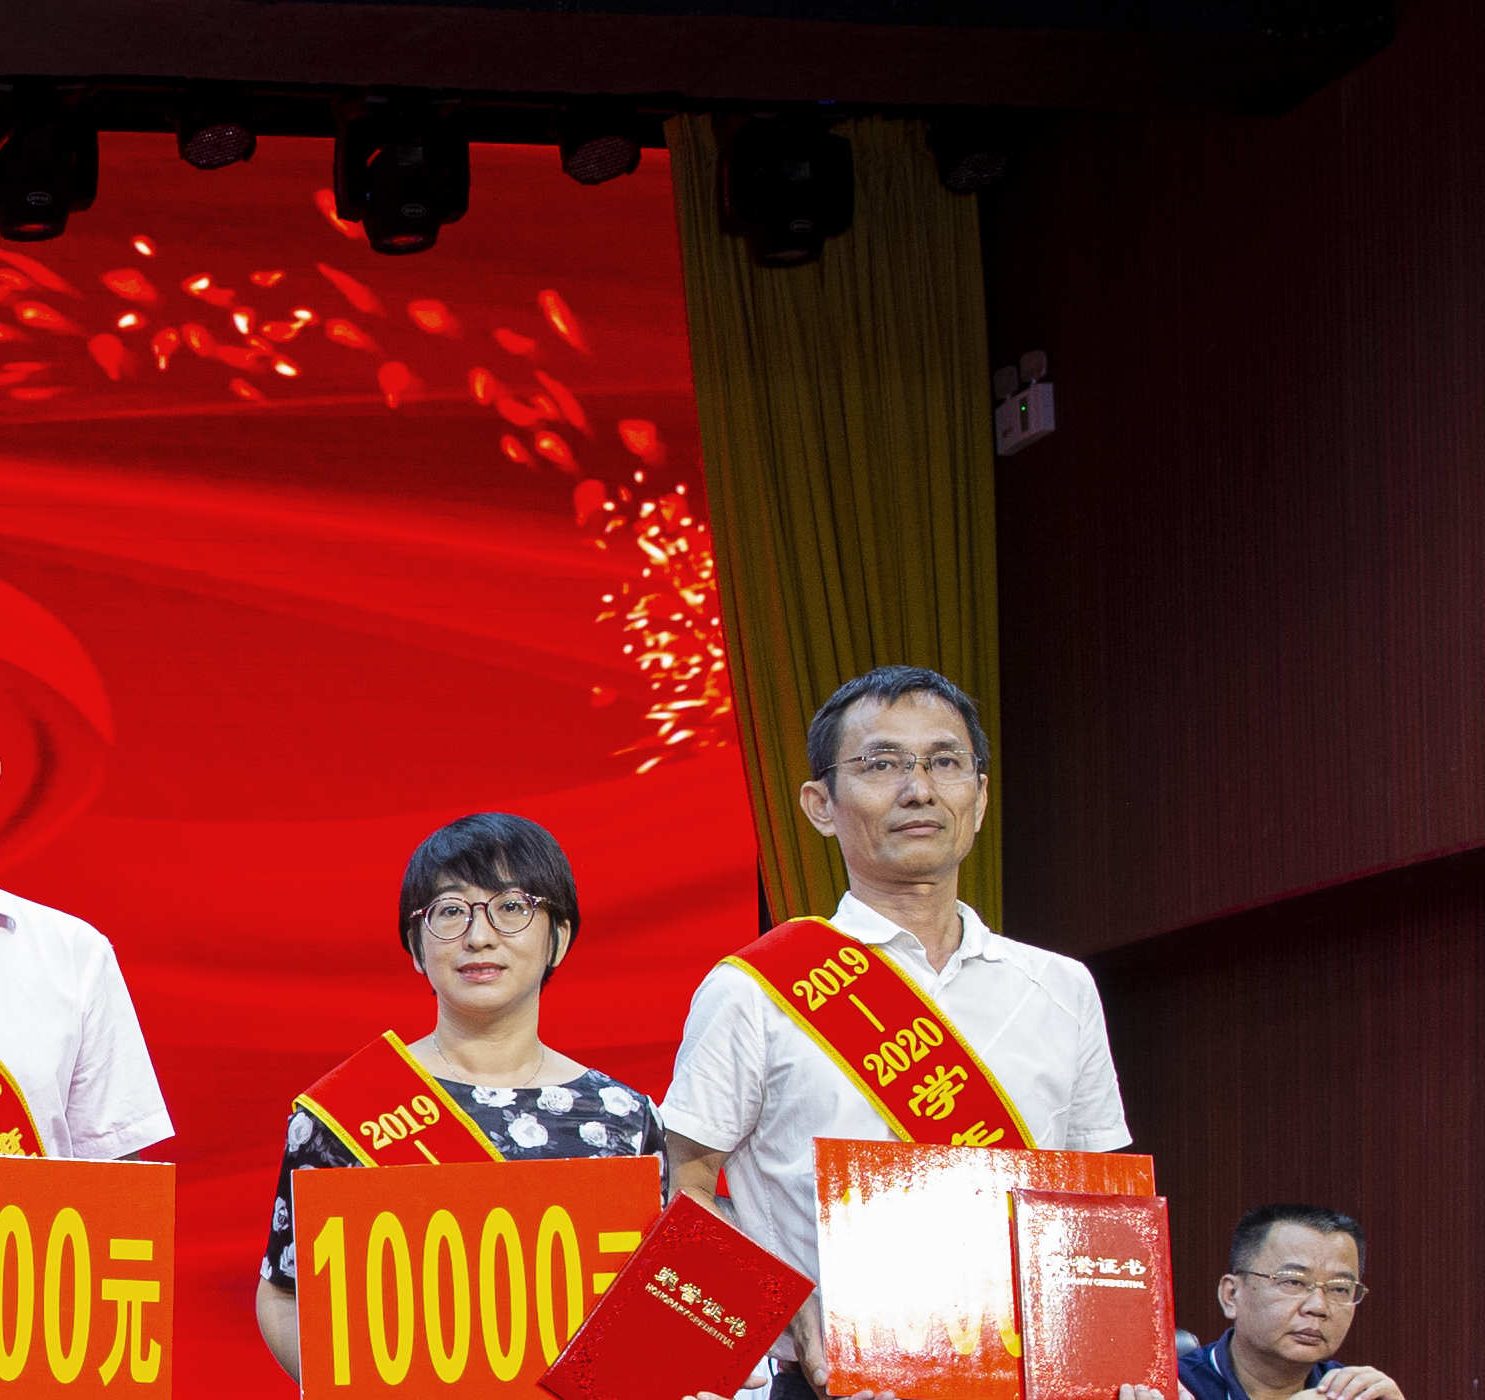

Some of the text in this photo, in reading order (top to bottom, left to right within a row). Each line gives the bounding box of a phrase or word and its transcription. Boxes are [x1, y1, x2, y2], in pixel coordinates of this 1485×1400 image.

[792, 946, 870, 1012] 2019
[862, 1017, 944, 1088] 2020
[359, 1094, 440, 1150] 2019
[645, 1282, 690, 1316] HONORARY
[655, 1267, 747, 1337] 荣誉证书
